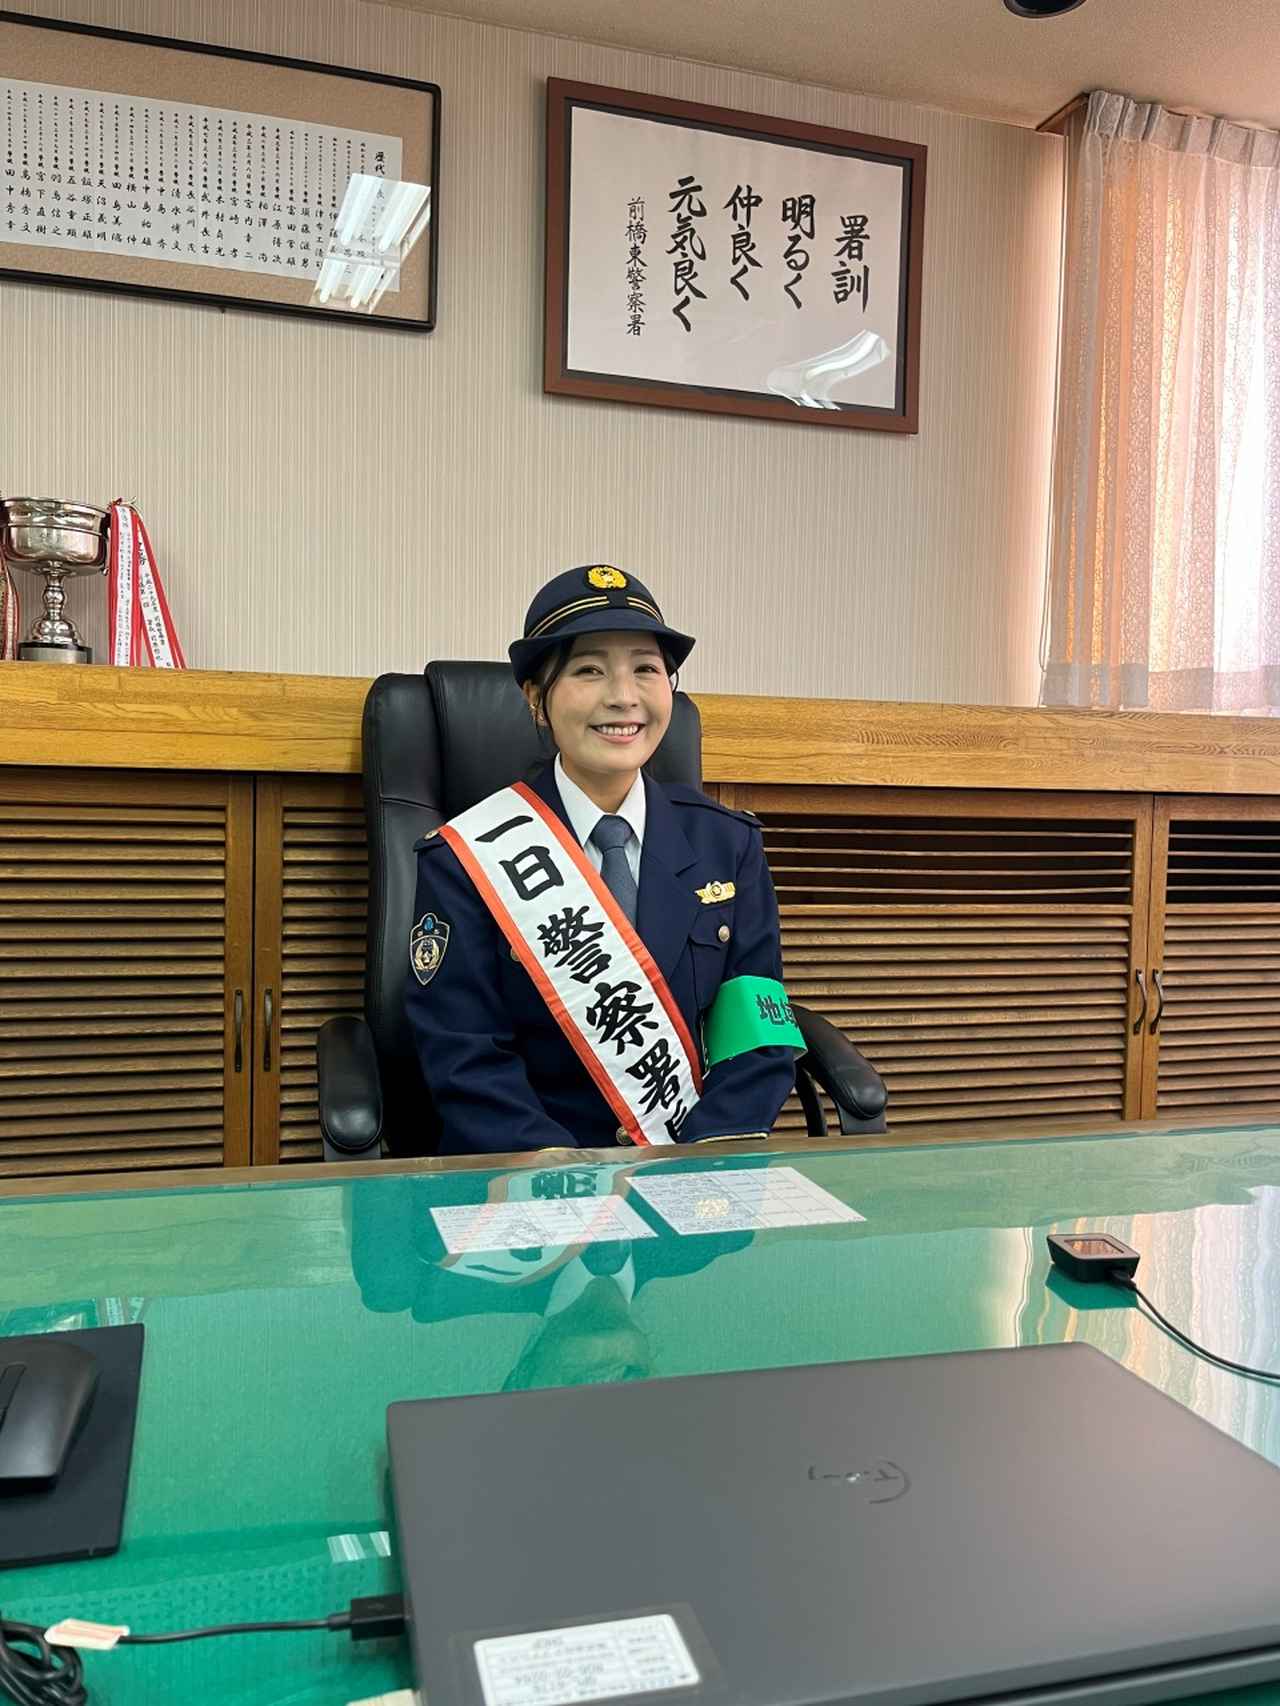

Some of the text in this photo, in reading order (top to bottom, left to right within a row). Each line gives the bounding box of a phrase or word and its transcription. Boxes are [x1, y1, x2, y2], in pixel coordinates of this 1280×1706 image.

[625, 196, 648, 336] 前橋東警察署
[665, 175, 708, 333] 元気良く
[722, 184, 764, 302] 仲良く
[781, 193, 817, 310] 明るく
[831, 214, 871, 313] 署訓
